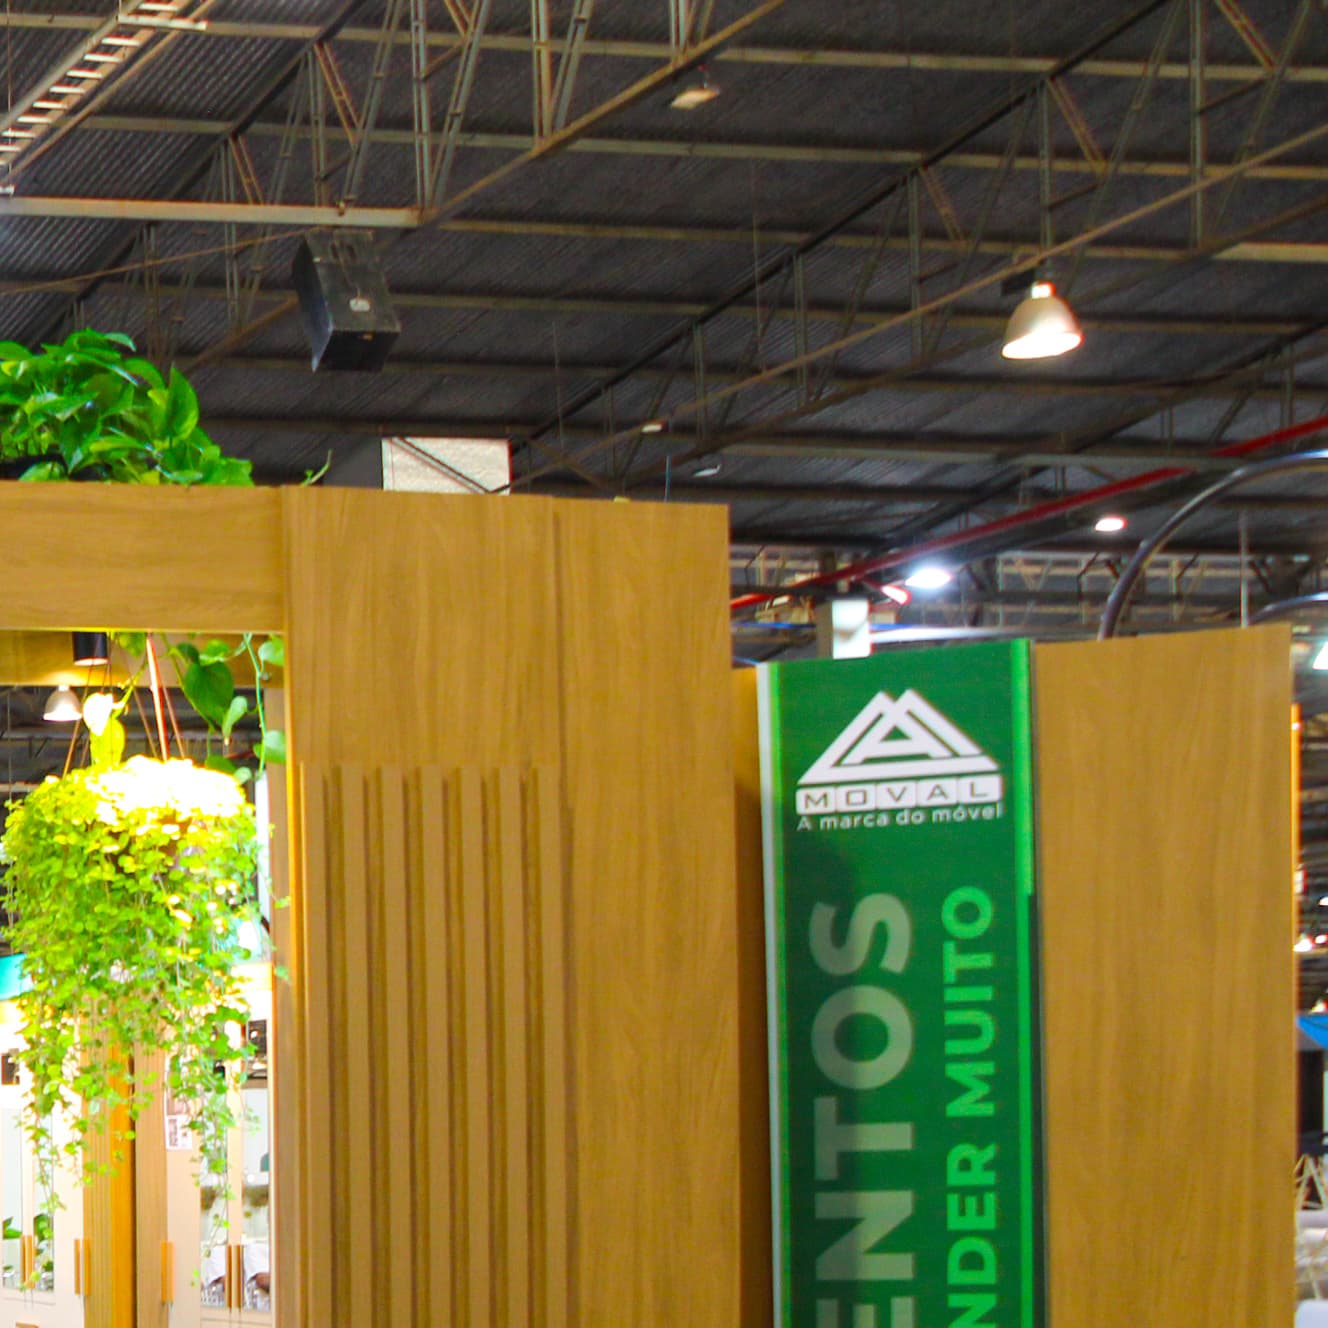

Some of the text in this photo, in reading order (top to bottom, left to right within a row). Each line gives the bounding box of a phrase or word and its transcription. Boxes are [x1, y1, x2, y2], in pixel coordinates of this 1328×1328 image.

[802, 780, 992, 811] MOVAL
[796, 802, 1002, 831] A marca do móvel
[942, 884, 996, 1118] MUITO
